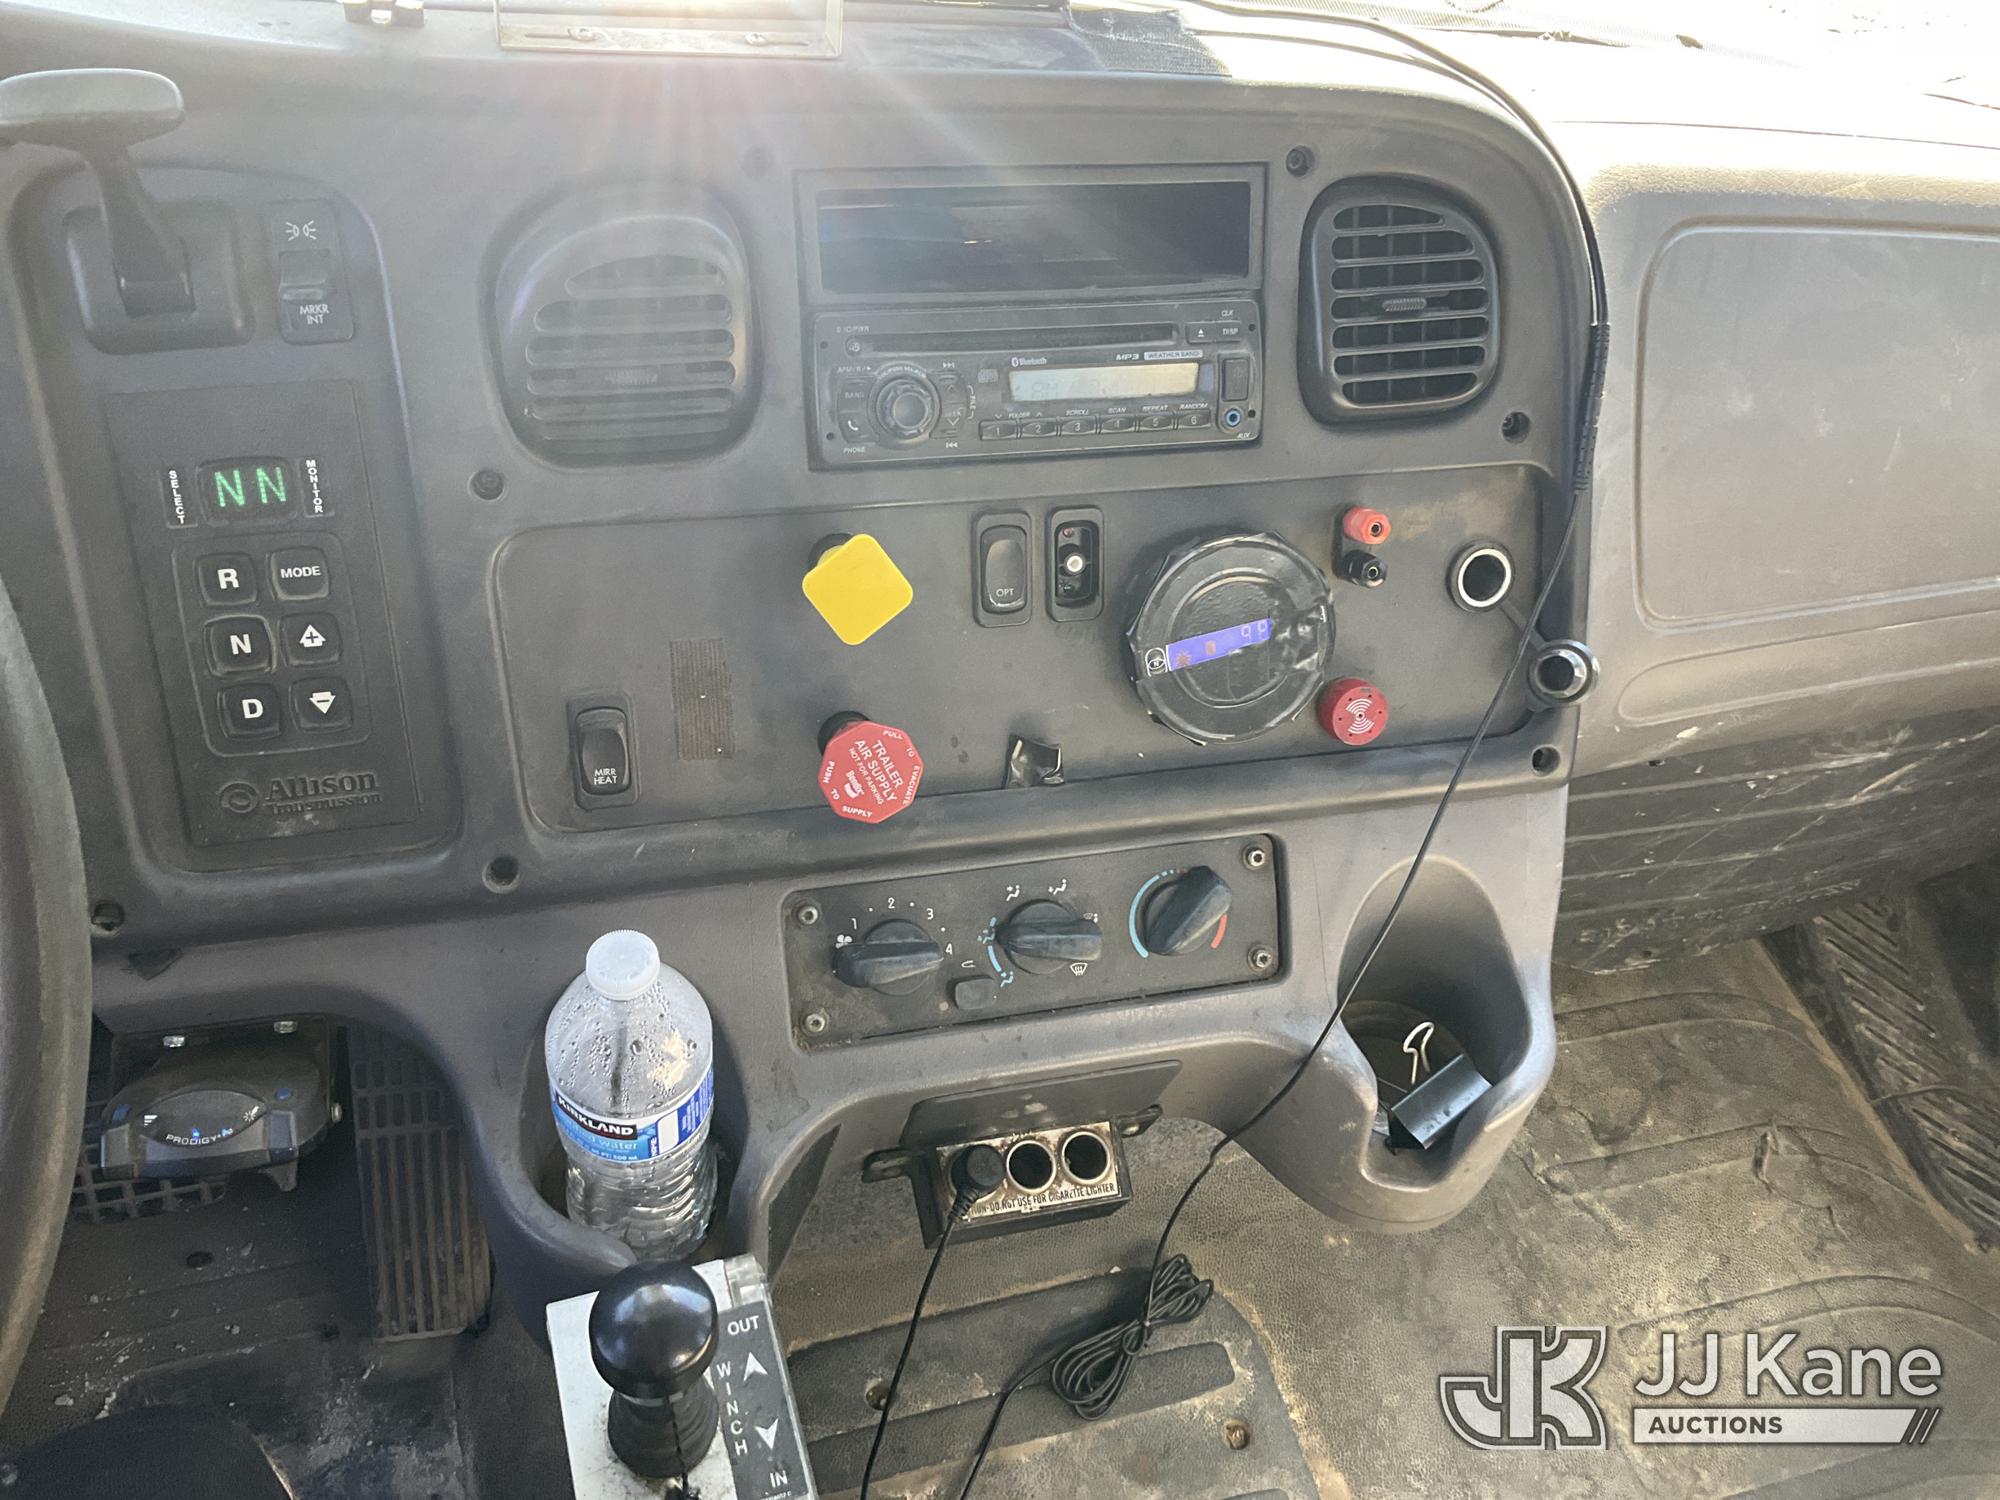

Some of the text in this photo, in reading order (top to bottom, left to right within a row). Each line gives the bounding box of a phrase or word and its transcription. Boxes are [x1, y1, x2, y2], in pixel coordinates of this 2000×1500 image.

[299, 303, 329, 314] MRKR
[306, 313, 324, 325] INT
[1222, 327, 1239, 336] DISP
[1115, 353, 1139, 361] MP3
[1147, 351, 1181, 359] WEATHER
[306, 459, 323, 513] MONITOR
[168, 470, 185, 524] SELECT
[218, 568, 240, 590] R
[280, 565, 321, 579] MODE
[996, 587, 1015, 598] OPT
[230, 634, 252, 655] N
[241, 699, 264, 719] D
[883, 730, 903, 740] PULL
[905, 747, 915, 757] TO
[594, 768, 617, 776] MIRR
[855, 740, 897, 801] AIR SUPPLY
[872, 740, 904, 788] TRAILER
[265, 771, 379, 801] Allison
[594, 775, 618, 785] HEAT
[848, 747, 884, 805] NOT FOR PARKING
[823, 760, 873, 818] PUSH TO SUPPLY
[888, 898, 895, 909] 2
[926, 908, 934, 920] 3
[945, 943, 953, 955] 4
[558, 1096, 634, 1135] KIRKLAND
[165, 1133, 217, 1145] PRODIGY
[1017, 1196, 1032, 1207] USE
[1033, 1194, 1047, 1203] FOR
[1048, 1187, 1085, 1202] CIGARETTE
[1086, 1182, 1116, 1197] LIGHTER
[727, 1315, 760, 1336] OUT
[716, 1361, 748, 1456] WINCH
[769, 1469, 788, 1488] IN
